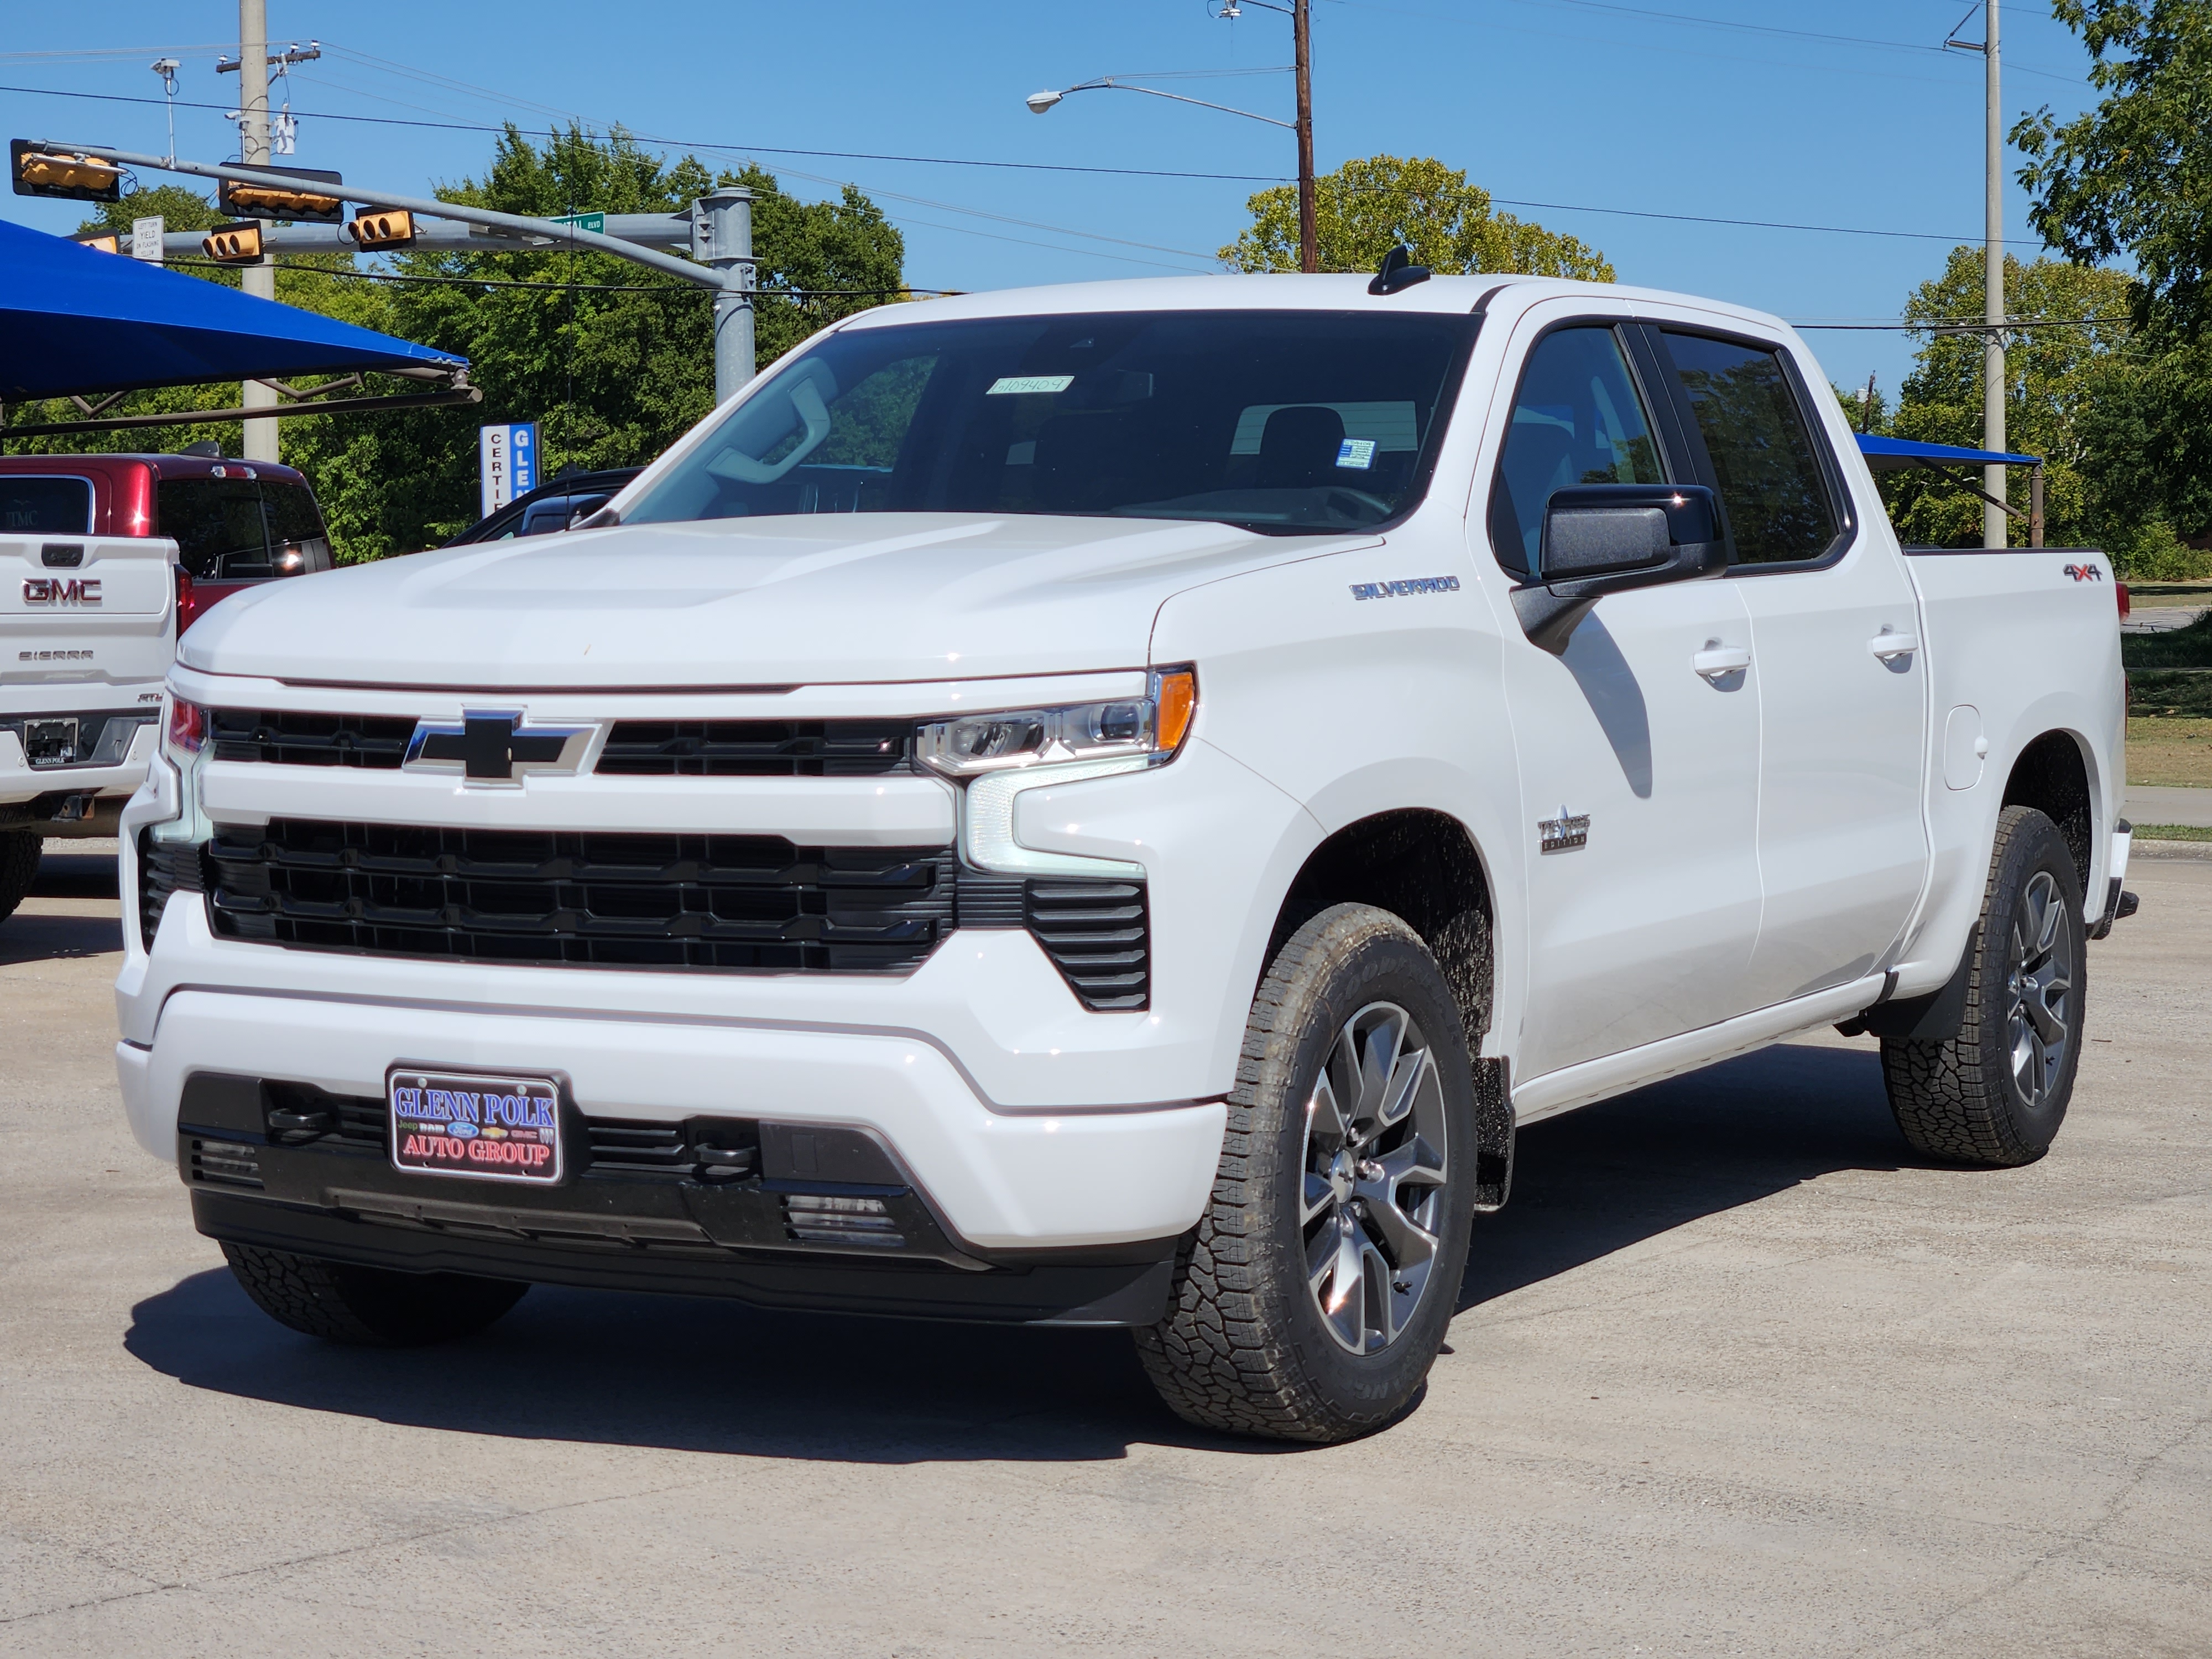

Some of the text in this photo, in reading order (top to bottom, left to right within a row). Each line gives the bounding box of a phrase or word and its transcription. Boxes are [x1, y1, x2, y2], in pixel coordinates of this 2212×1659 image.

[588, 221, 601, 229] BLVD
[140, 230, 155, 239] YIELD
[143, 239, 159, 248] FLASHING
[22, 578, 102, 604] GMC
[1349, 576, 1460, 601] SILVERADO
[18, 650, 93, 661] SIERRA
[1545, 836, 1584, 849] EDITION
[395, 1087, 555, 1128] GLENN POLK
[398, 1120, 418, 1131] Jeep
[419, 1122, 445, 1133] RAM
[510, 1130, 538, 1139] GMC
[403, 1134, 550, 1166] AUTO GROUP
